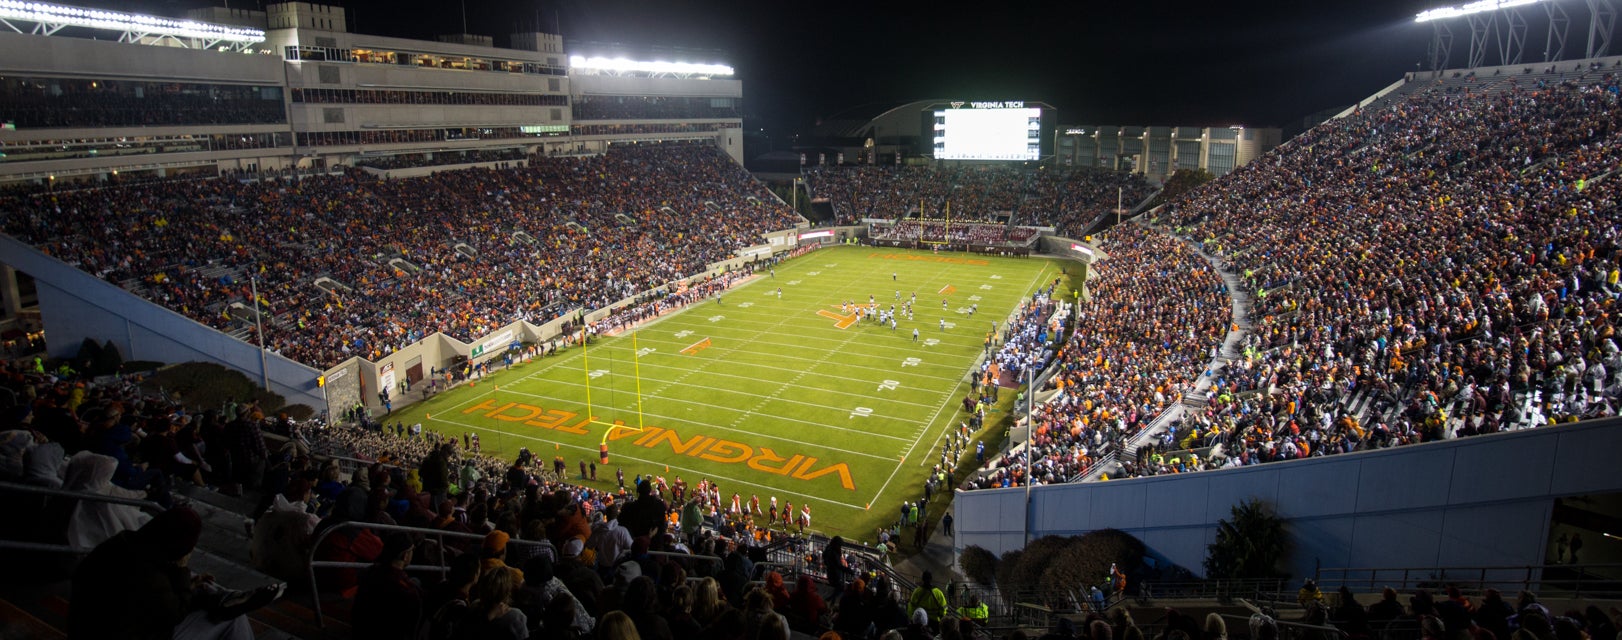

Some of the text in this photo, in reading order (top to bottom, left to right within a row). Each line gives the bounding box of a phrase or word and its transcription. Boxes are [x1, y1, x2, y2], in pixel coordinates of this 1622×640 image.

[970, 101, 1003, 109] VIRGINIA
[878, 380, 900, 391] 20
[850, 407, 874, 418] 10
[462, 398, 857, 491] VIRGINIA TECH
